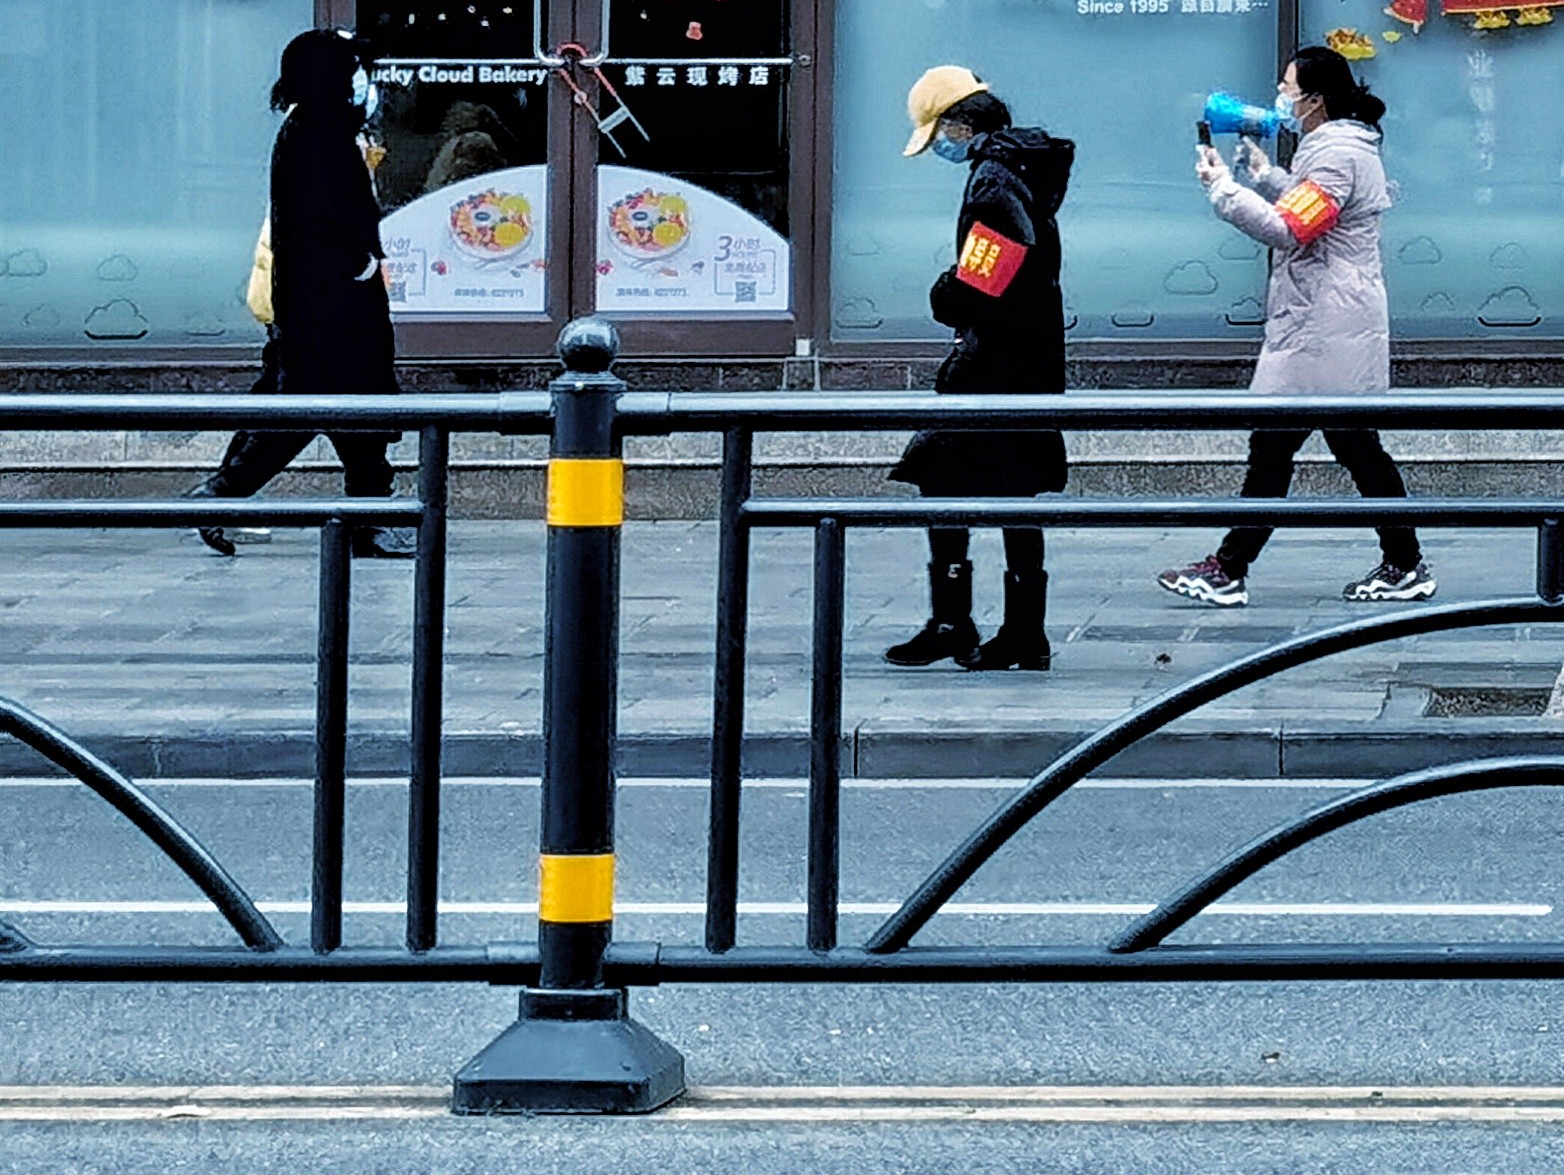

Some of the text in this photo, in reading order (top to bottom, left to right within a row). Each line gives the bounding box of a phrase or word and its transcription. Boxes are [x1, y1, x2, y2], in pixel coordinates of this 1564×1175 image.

[371, 65, 550, 87] ucky Cloud Bakery
[624, 65, 770, 87] 紫云现烤店
